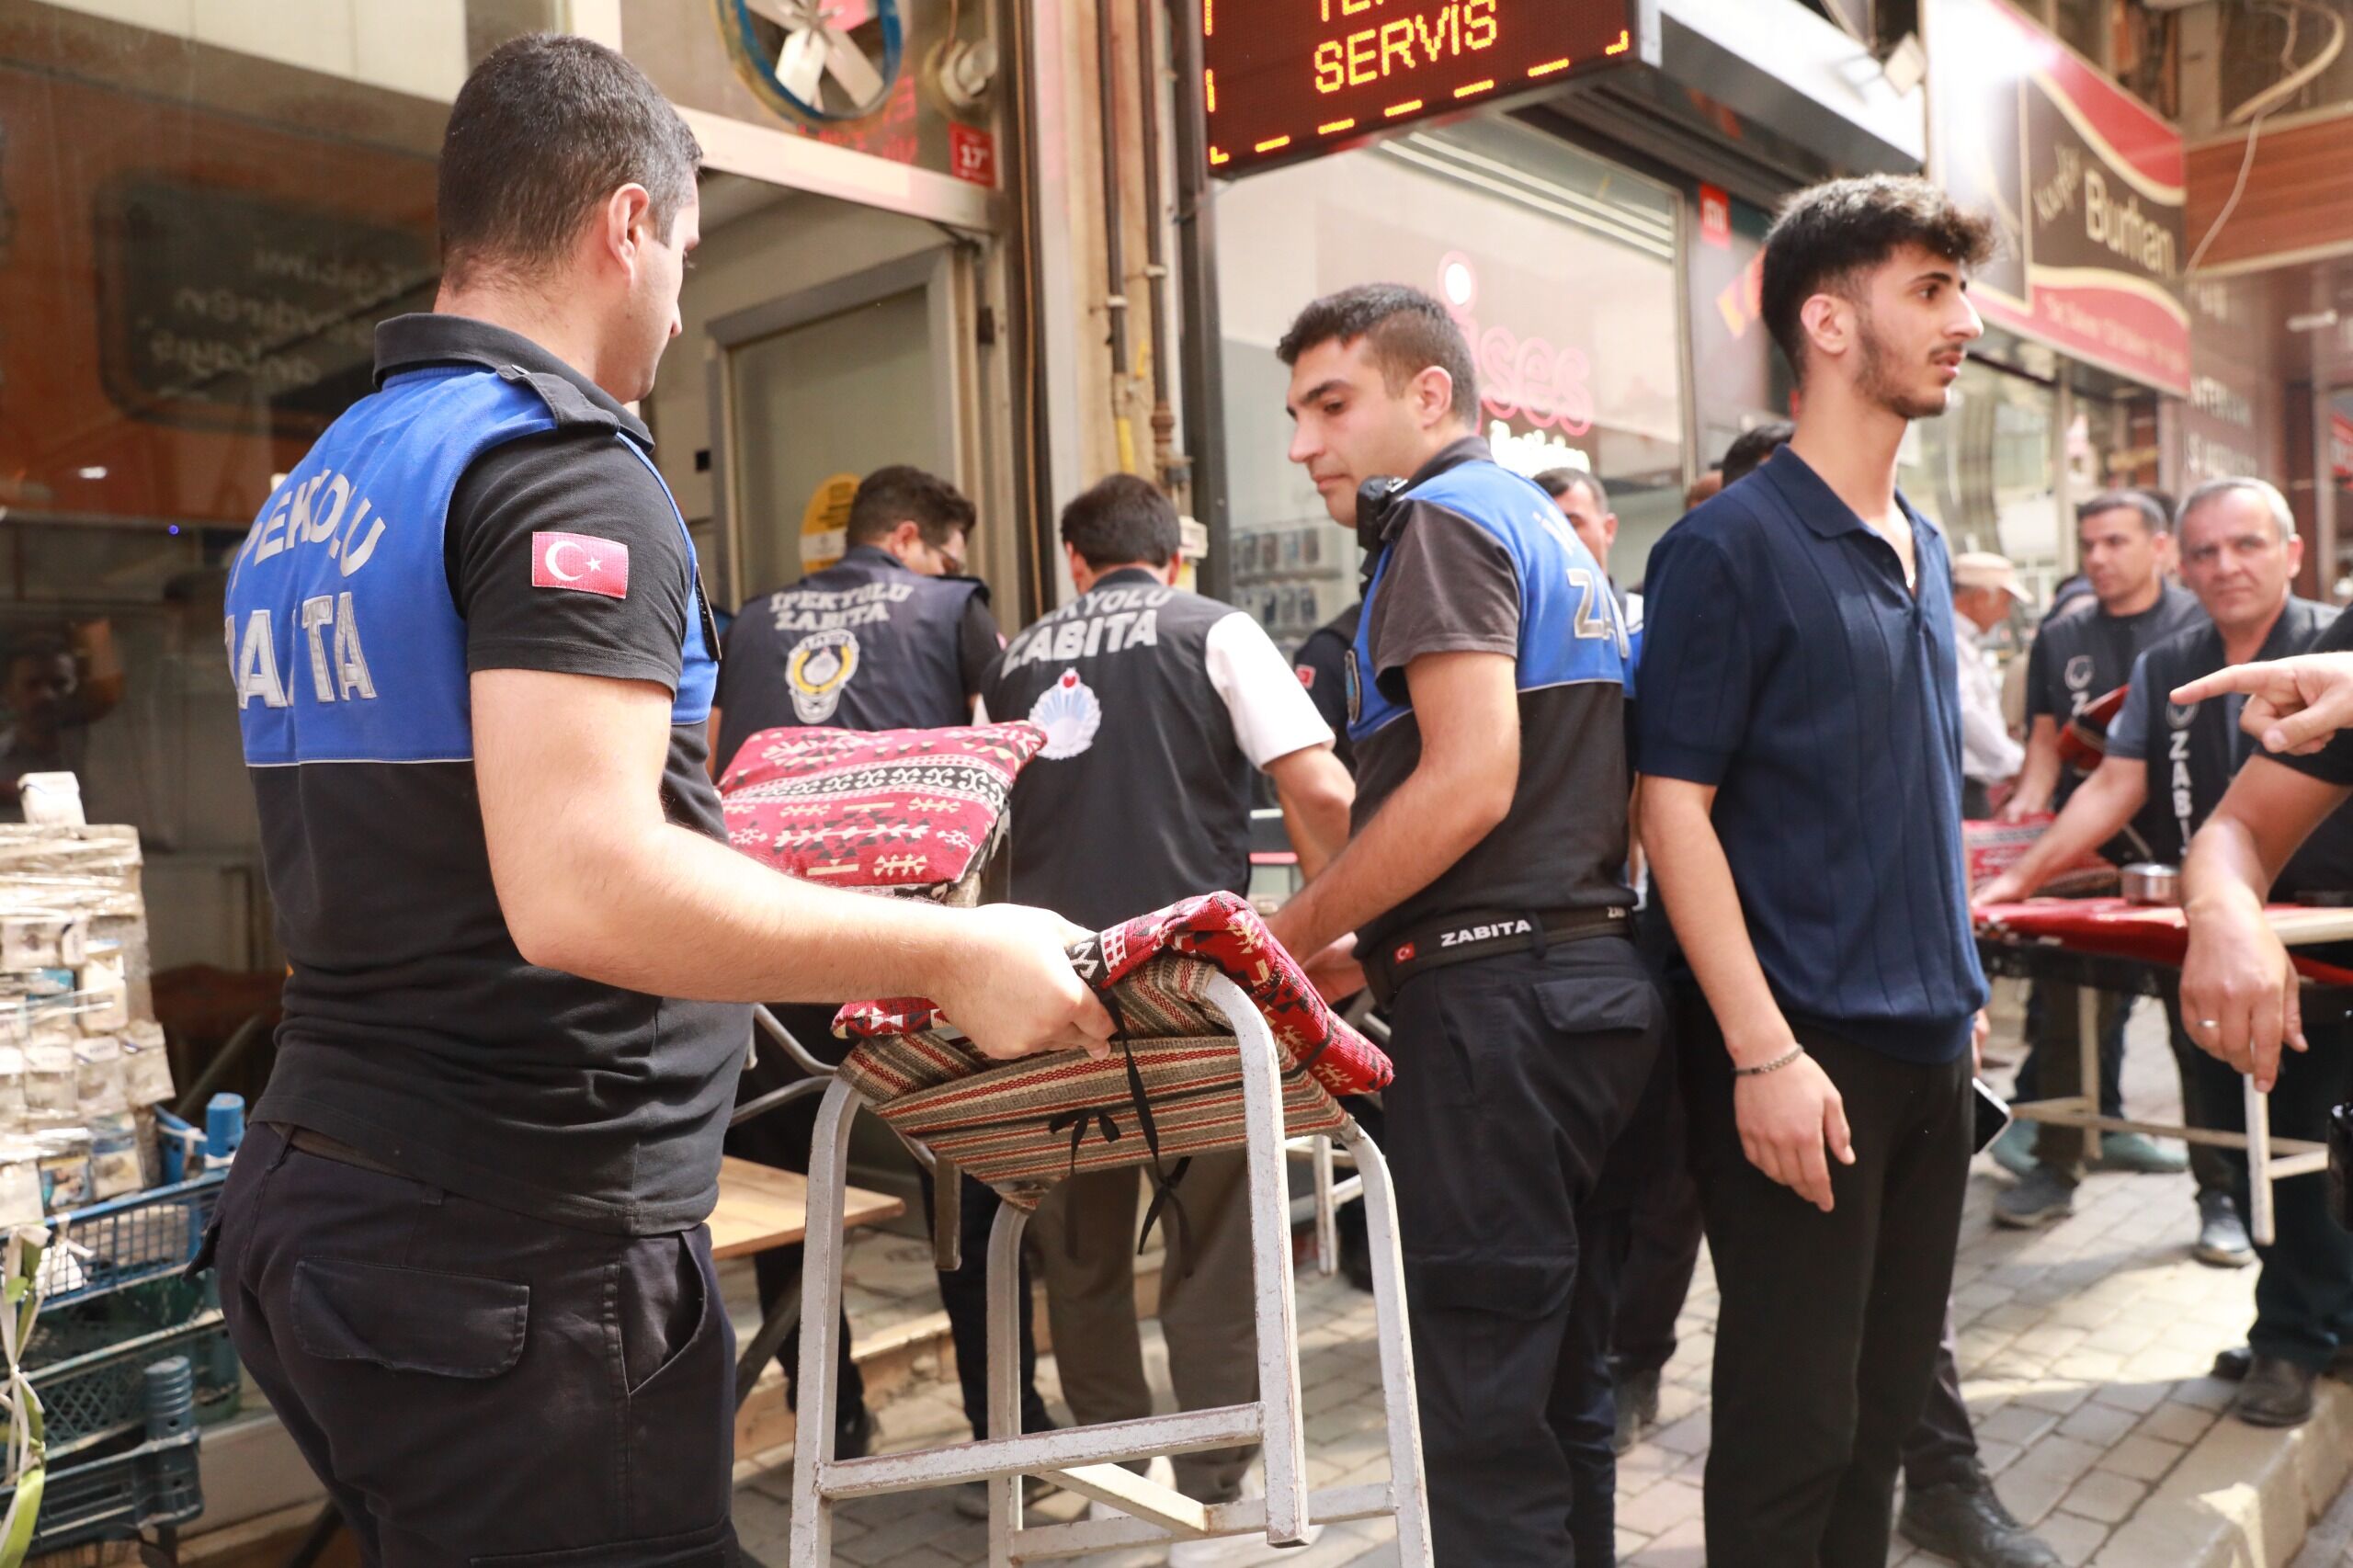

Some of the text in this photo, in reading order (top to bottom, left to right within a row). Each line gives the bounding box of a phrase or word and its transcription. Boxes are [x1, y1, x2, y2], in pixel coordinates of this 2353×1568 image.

[2084, 166, 2177, 279] Burhan
[774, 602, 891, 631] ZABITA
[1440, 919, 1532, 948] ZABITA
